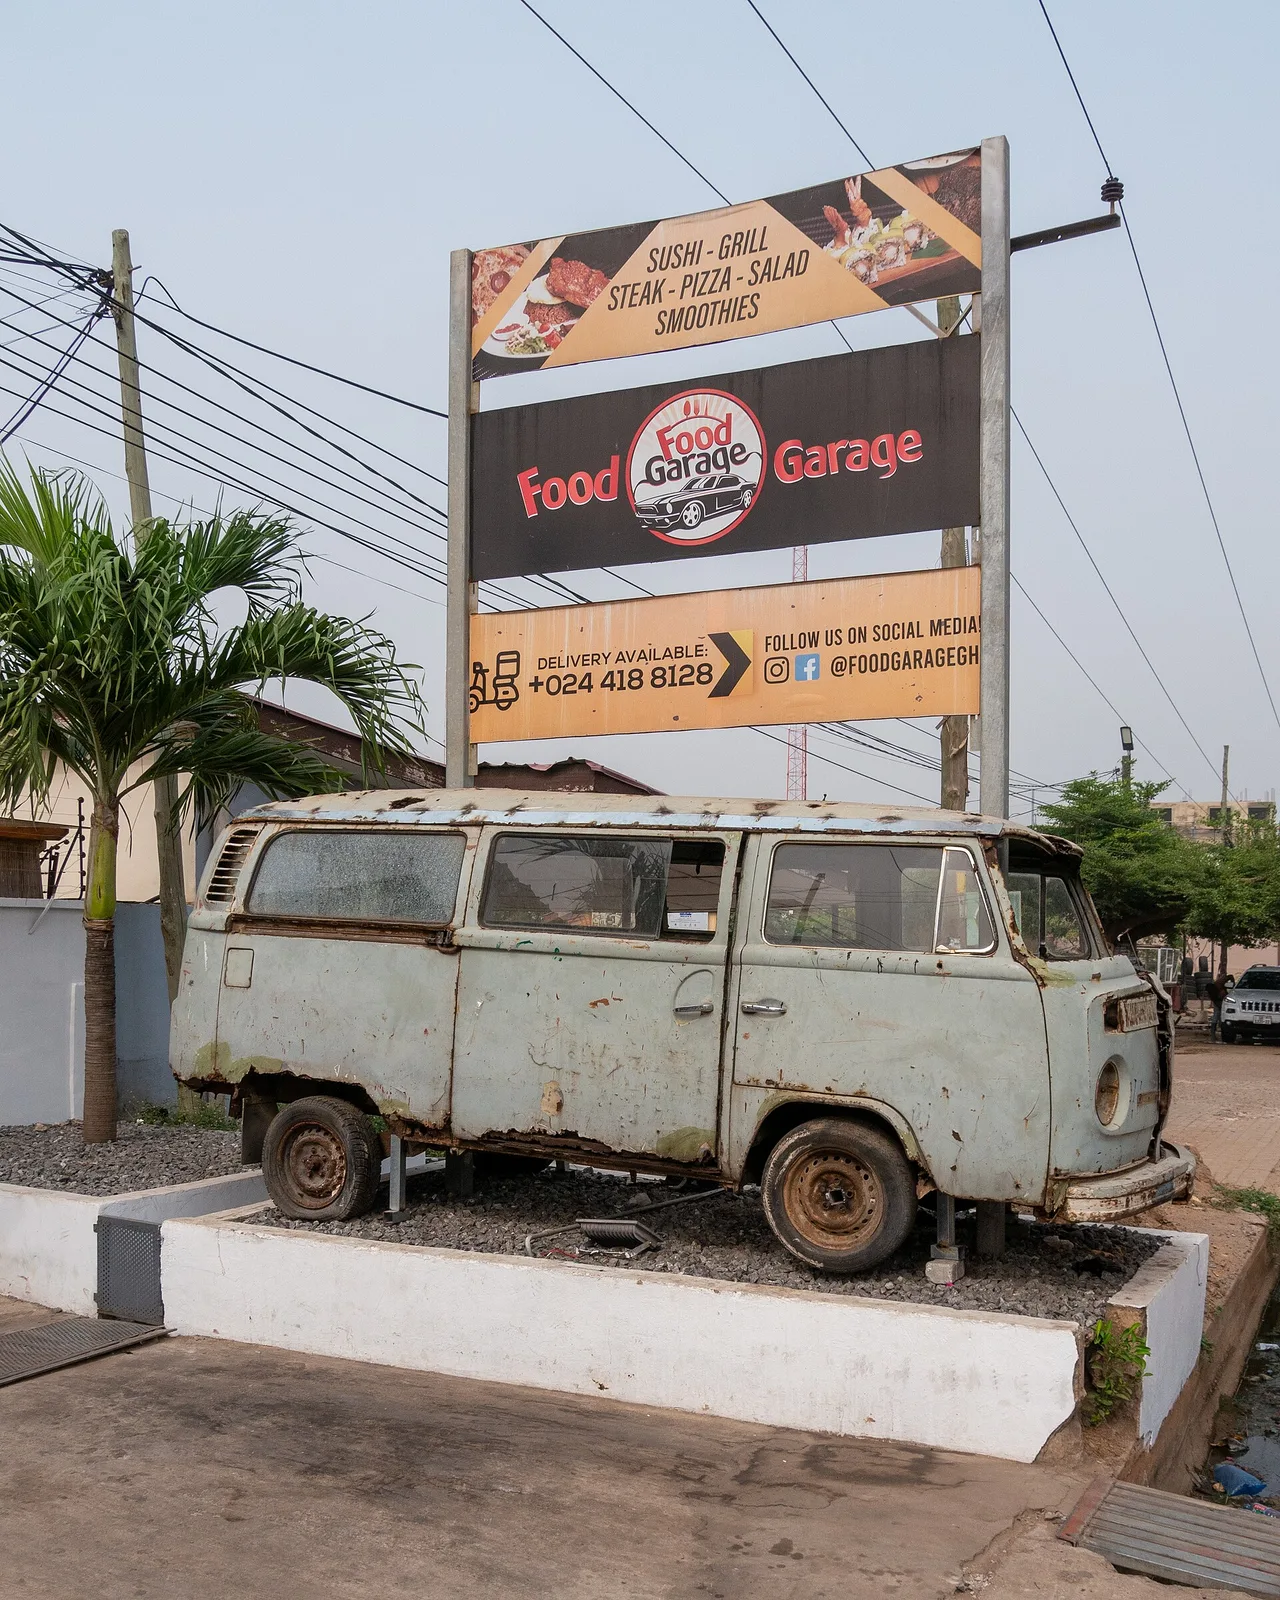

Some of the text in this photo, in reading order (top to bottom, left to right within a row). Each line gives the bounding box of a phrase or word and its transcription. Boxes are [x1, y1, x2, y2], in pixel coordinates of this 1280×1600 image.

[647, 239, 704, 274] SUSHI
[718, 226, 768, 261] GRILL
[607, 278, 667, 312] STEAK
[679, 266, 732, 300] PIZZA
[747, 249, 810, 287] SALAD
[654, 292, 761, 336] SMOOTHIES
[656, 413, 733, 461] Food
[517, 429, 924, 519] Food Garage
[645, 442, 748, 487] Garage
[538, 644, 709, 671] DELIVERY AVAILABLE:
[765, 630, 820, 653] FOLLOW
[825, 628, 843, 648] US
[848, 626, 868, 645] ON
[872, 620, 925, 642] SOCIAL
[528, 662, 714, 696] +024 418 8128
[830, 645, 979, 678] @FOODGARAGEGH
